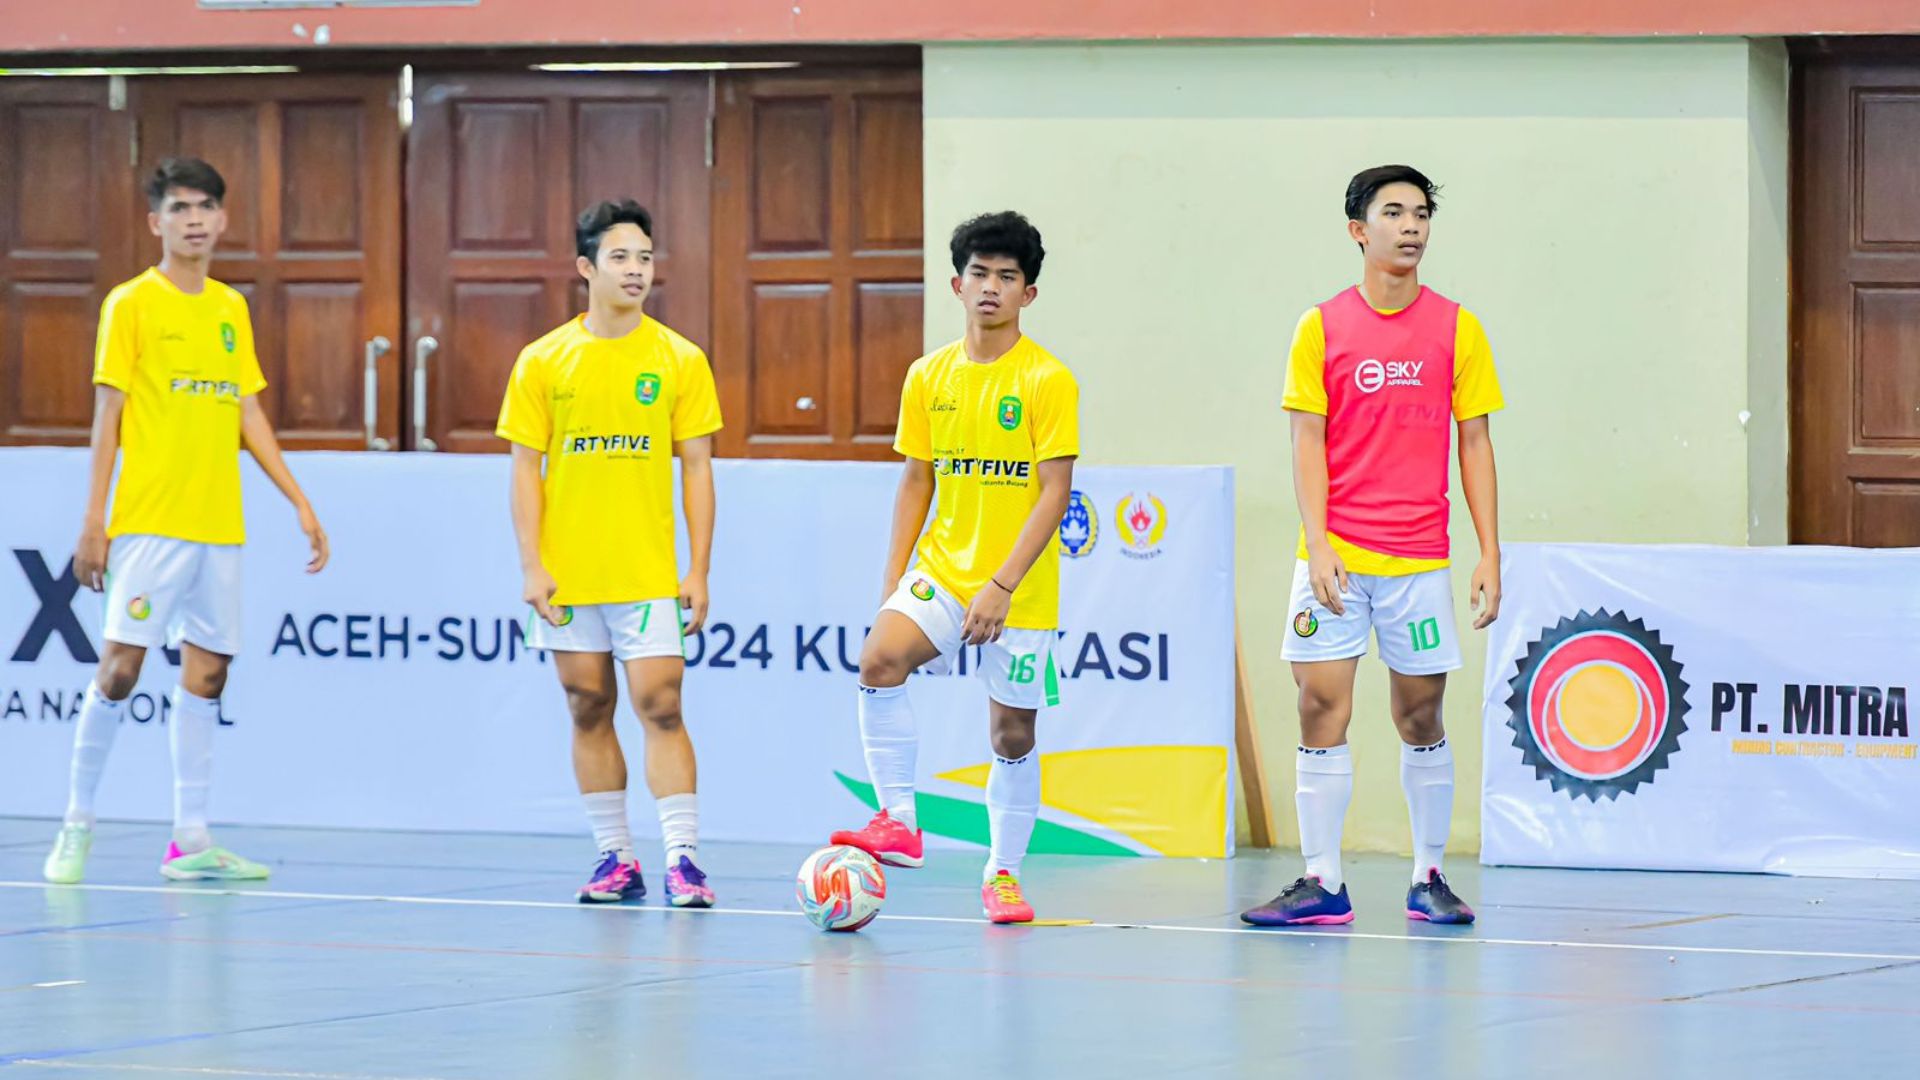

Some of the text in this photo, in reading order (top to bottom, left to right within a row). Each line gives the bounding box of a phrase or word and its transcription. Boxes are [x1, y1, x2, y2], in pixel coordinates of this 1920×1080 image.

[1386, 360, 1424, 378] SKY
[1386, 379, 1424, 387] APPAREL
[634, 603, 651, 633] 7
[271, 613, 547, 662] ACEH-SUM
[682, 622, 773, 669] 024
[1408, 617, 1441, 651] 10
[1008, 653, 1036, 683] 16
[0, 690, 27, 719] A
[1711, 682, 1909, 737] PT. MITRA
[1732, 740, 1772, 755] MINING
[1775, 742, 1845, 758] CONTRACTOR
[1855, 743, 1918, 760] EQUIPMENT
